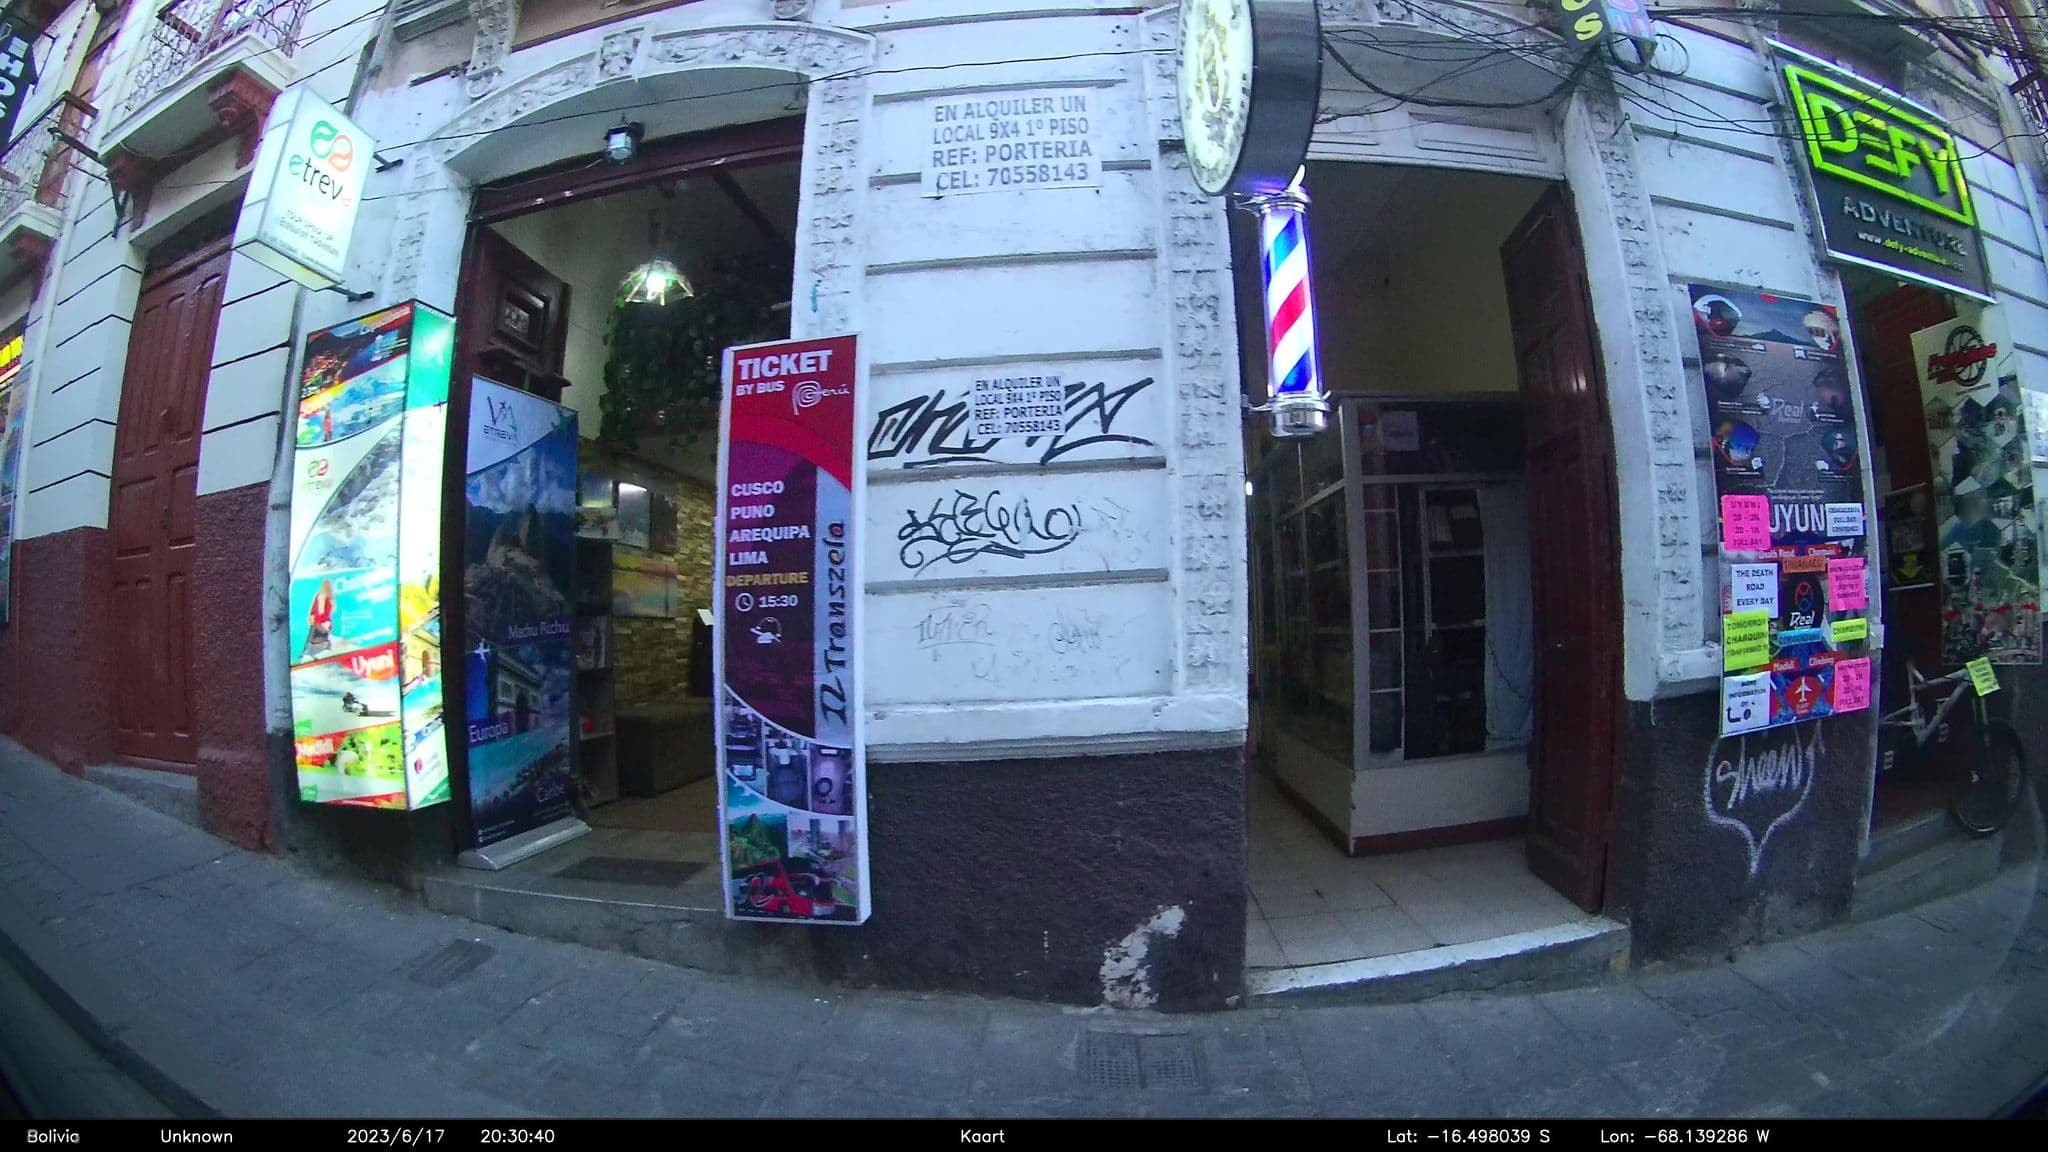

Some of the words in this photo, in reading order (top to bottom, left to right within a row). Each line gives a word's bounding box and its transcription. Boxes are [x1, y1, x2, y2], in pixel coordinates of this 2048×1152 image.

[935, 105, 957, 122] EN
[963, 97, 1055, 120] ALQUILER
[1061, 95, 1086, 113] UN
[933, 124, 985, 145] LOCAL
[990, 121, 1020, 139] 9X4
[1050, 117, 1089, 136] PISO
[1806, 93, 1951, 195] DEFY
[933, 147, 977, 168] REF:
[985, 140, 1092, 163] PORTERIA
[936, 170, 980, 190] CEL:
[986, 162, 1089, 187] 70558143
[738, 350, 833, 380] TICKET
[736, 384, 755, 396] BY
[757, 381, 785, 394] BUS
[1004, 405, 1062, 419] PORTERIA
[731, 481, 784, 497] CUSCO
[730, 504, 775, 519] PUNO
[729, 525, 811, 542] AREQUIPA
[729, 551, 768, 565] LIMA
[727, 572, 809, 587] DEPARTURE
[1736, 569, 1750, 578] THE
[1752, 569, 1774, 578] DEATH
[1746, 583, 1765, 592] ROAD
[759, 594, 799, 608] 15:30
[822, 520, 847, 674] Transzela
[1736, 597, 1758, 607] EVERY
[1760, 597, 1775, 606] DAY
[469, 723, 508, 743] Europa
